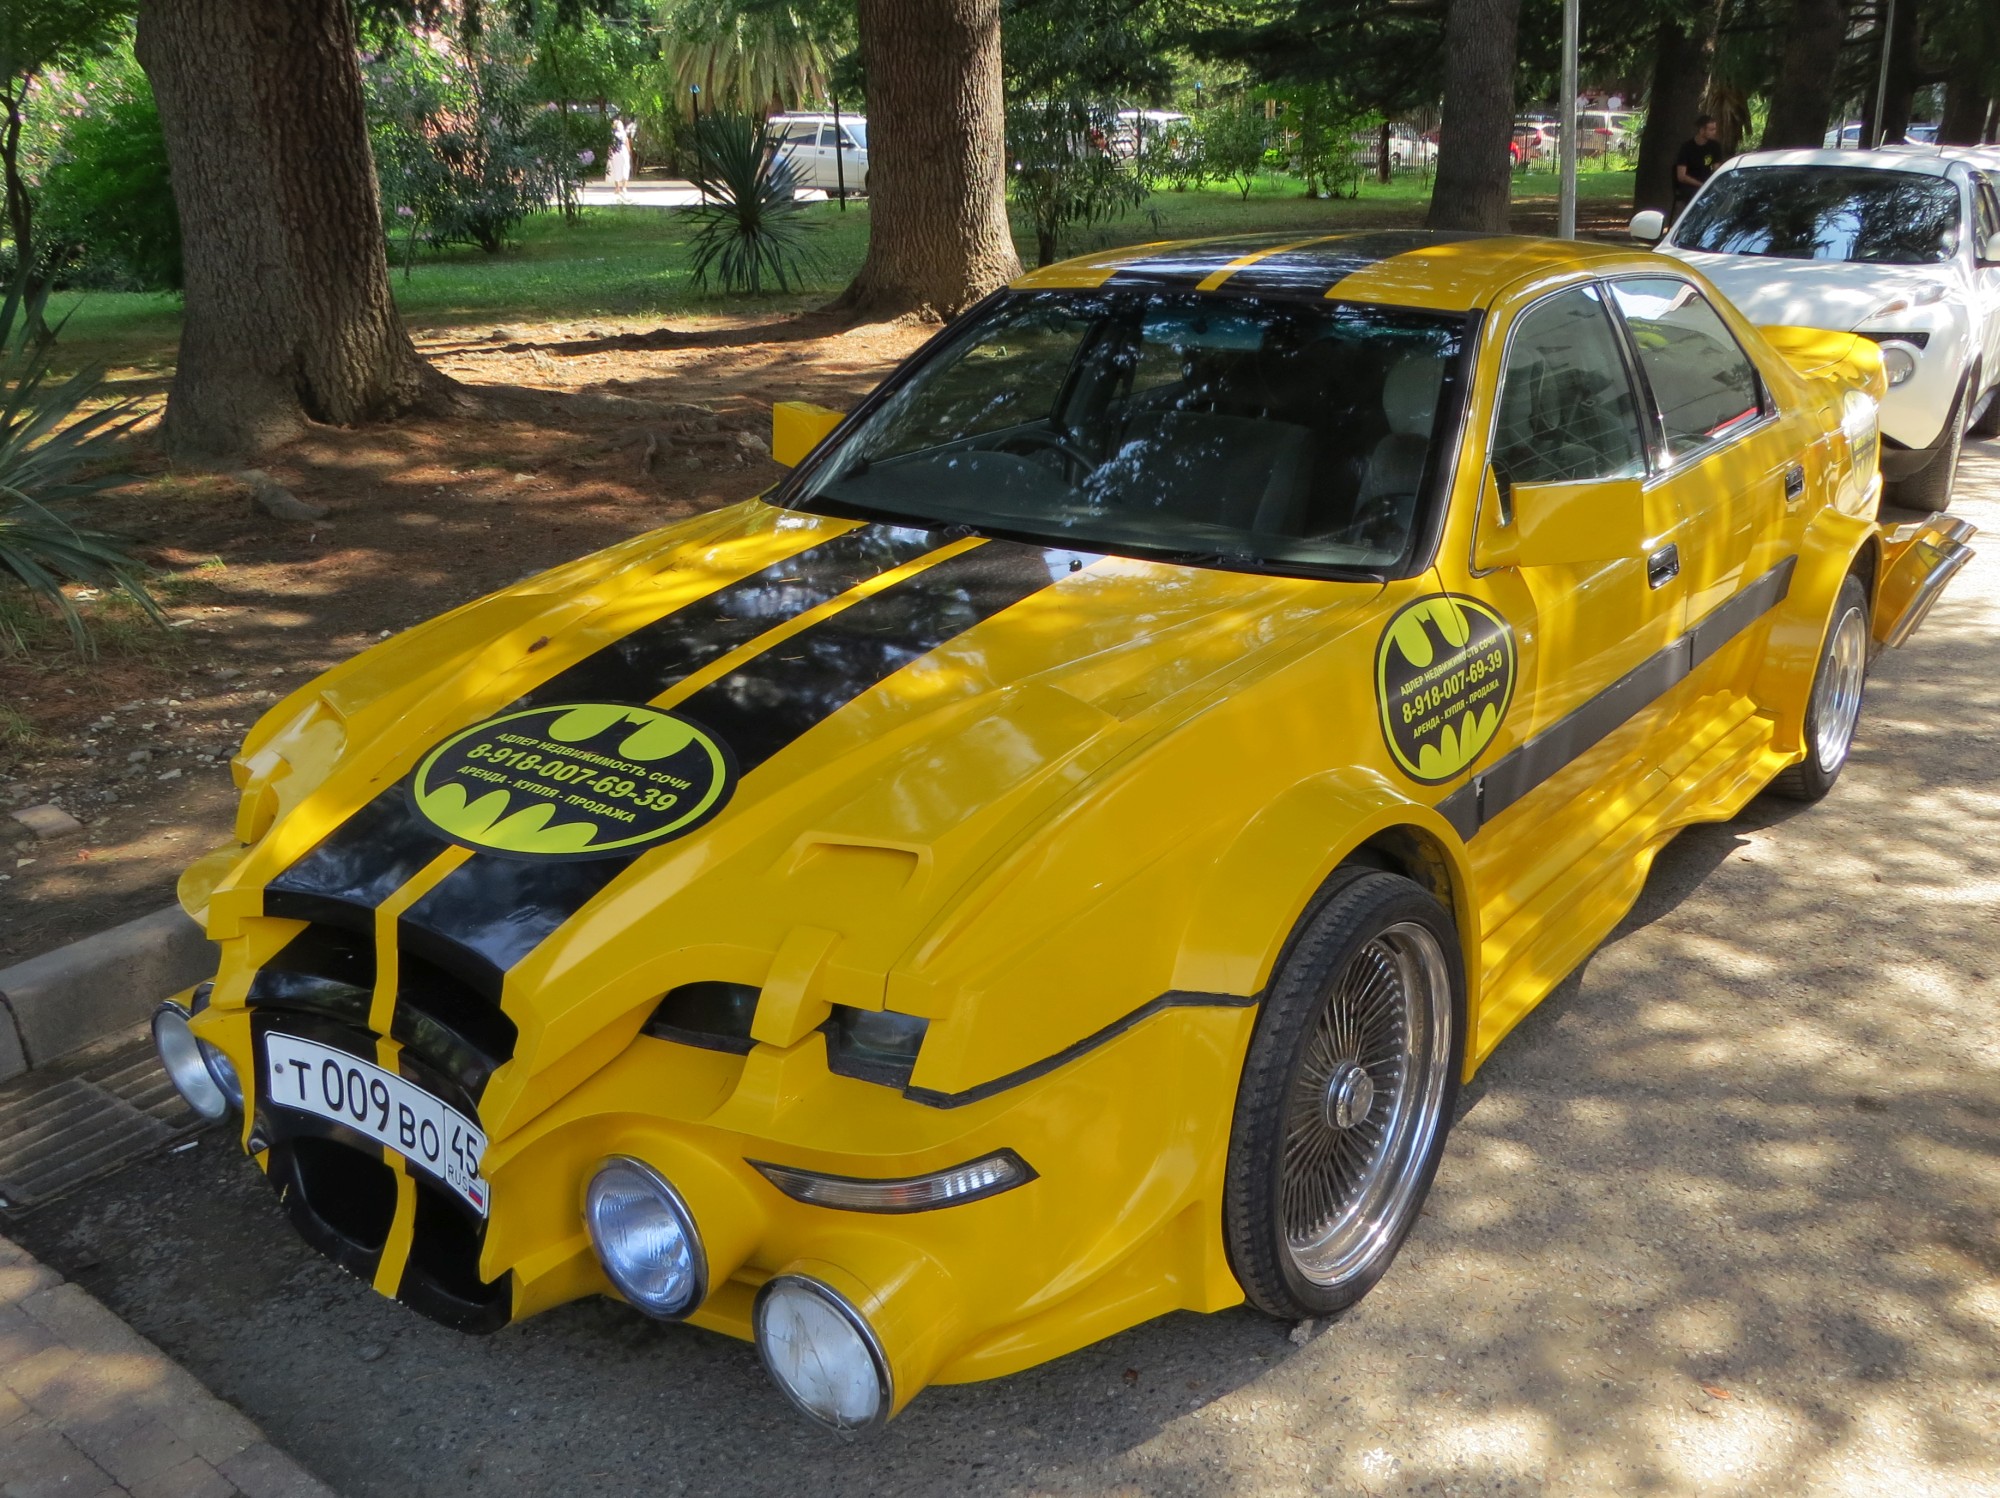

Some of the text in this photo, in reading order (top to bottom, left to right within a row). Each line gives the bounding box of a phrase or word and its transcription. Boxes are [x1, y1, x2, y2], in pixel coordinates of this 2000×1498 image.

[1400, 635, 1497, 697] АДЛЕР НЕДВИЖИМОСТЬ СОЧИ
[1401, 649, 1503, 724] 8-918-007-69-39
[1413, 715, 1441, 740] АРЕНДА
[1444, 698, 1466, 720] КУПЛЯ
[1469, 678, 1500, 704] ПРОДАЖА
[466, 743, 679, 812] 8-918-007-69-39
[495, 732, 692, 791] АДЛЕР НЕДВИЖИМОСТЬ СОЧИ
[456, 765, 508, 785] АРЕНДА
[513, 779, 561, 799] КУПЛЯ
[564, 794, 636, 824] ПРОДАЖА
[447, 1164, 469, 1192] RUS
[451, 1125, 479, 1181] 45
